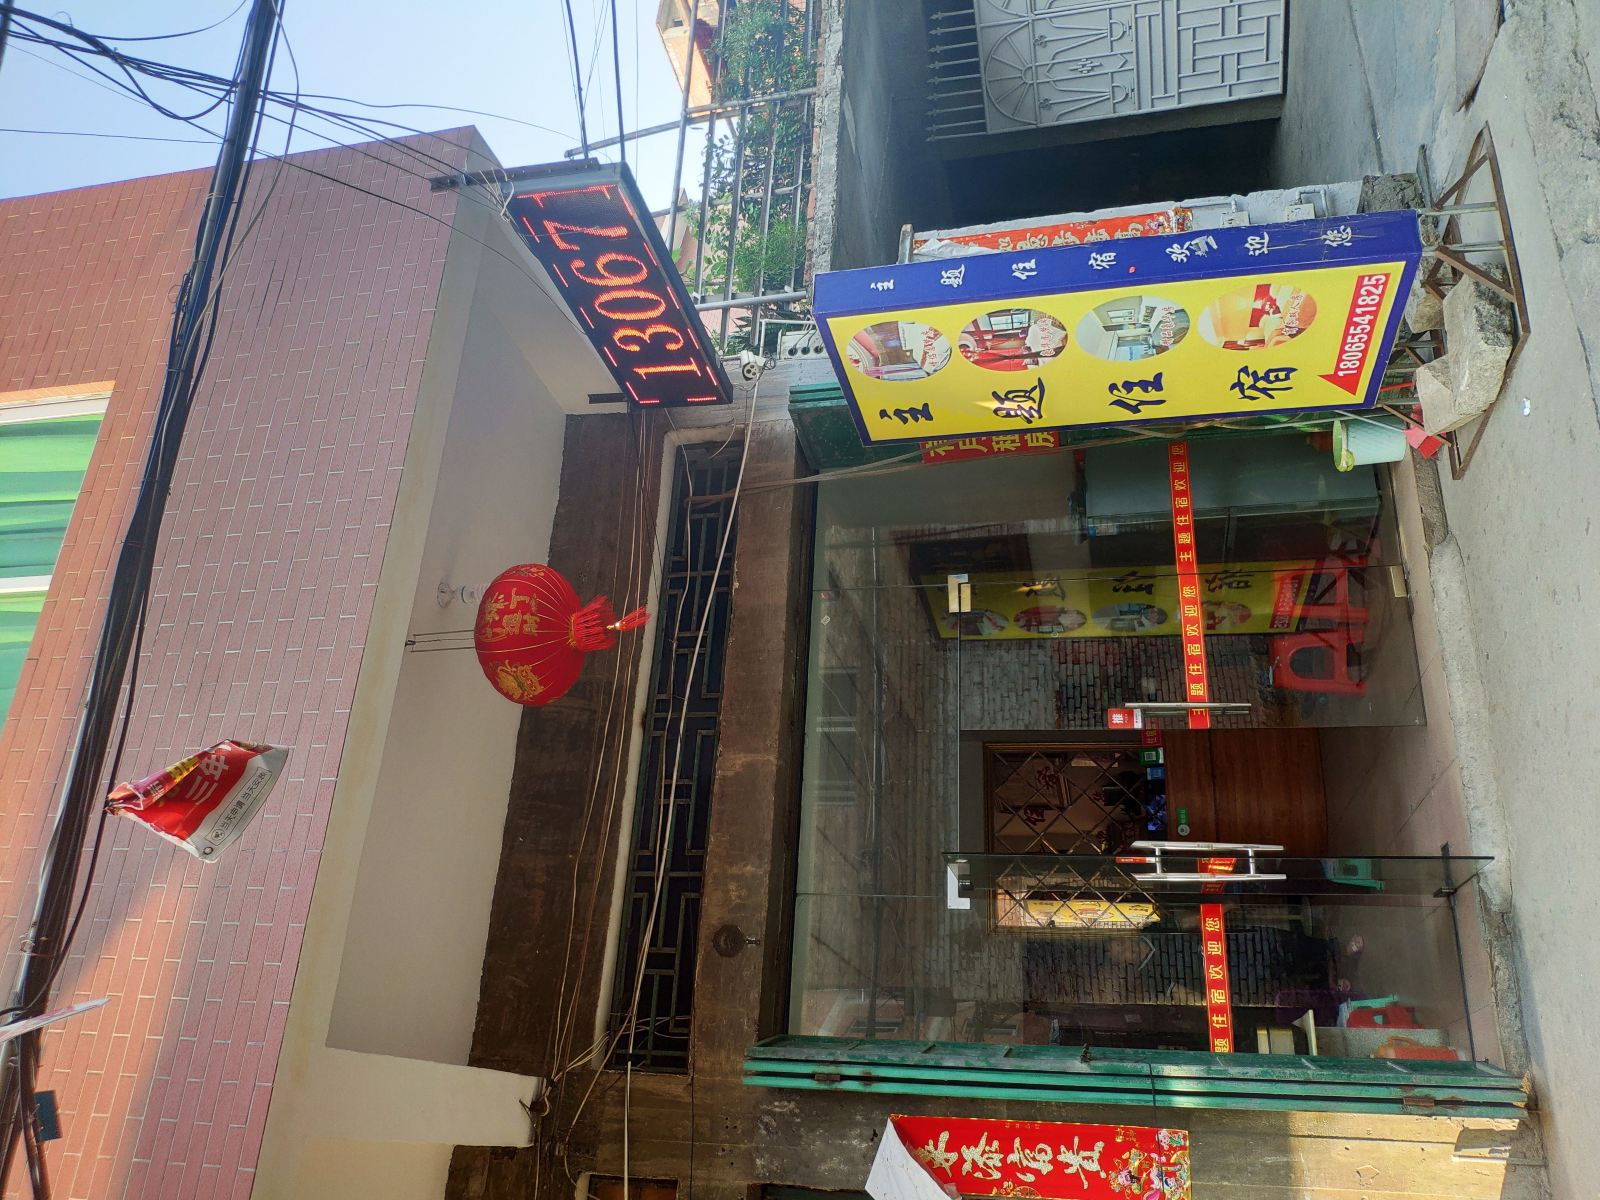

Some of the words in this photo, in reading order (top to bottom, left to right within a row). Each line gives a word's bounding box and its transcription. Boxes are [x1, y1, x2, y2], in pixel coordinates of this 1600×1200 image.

[1336, 274, 1387, 377] 18065541825
[878, 364, 1299, 425] 主题住宿
[1171, 443, 1193, 561] 主题住宿欢迎您
